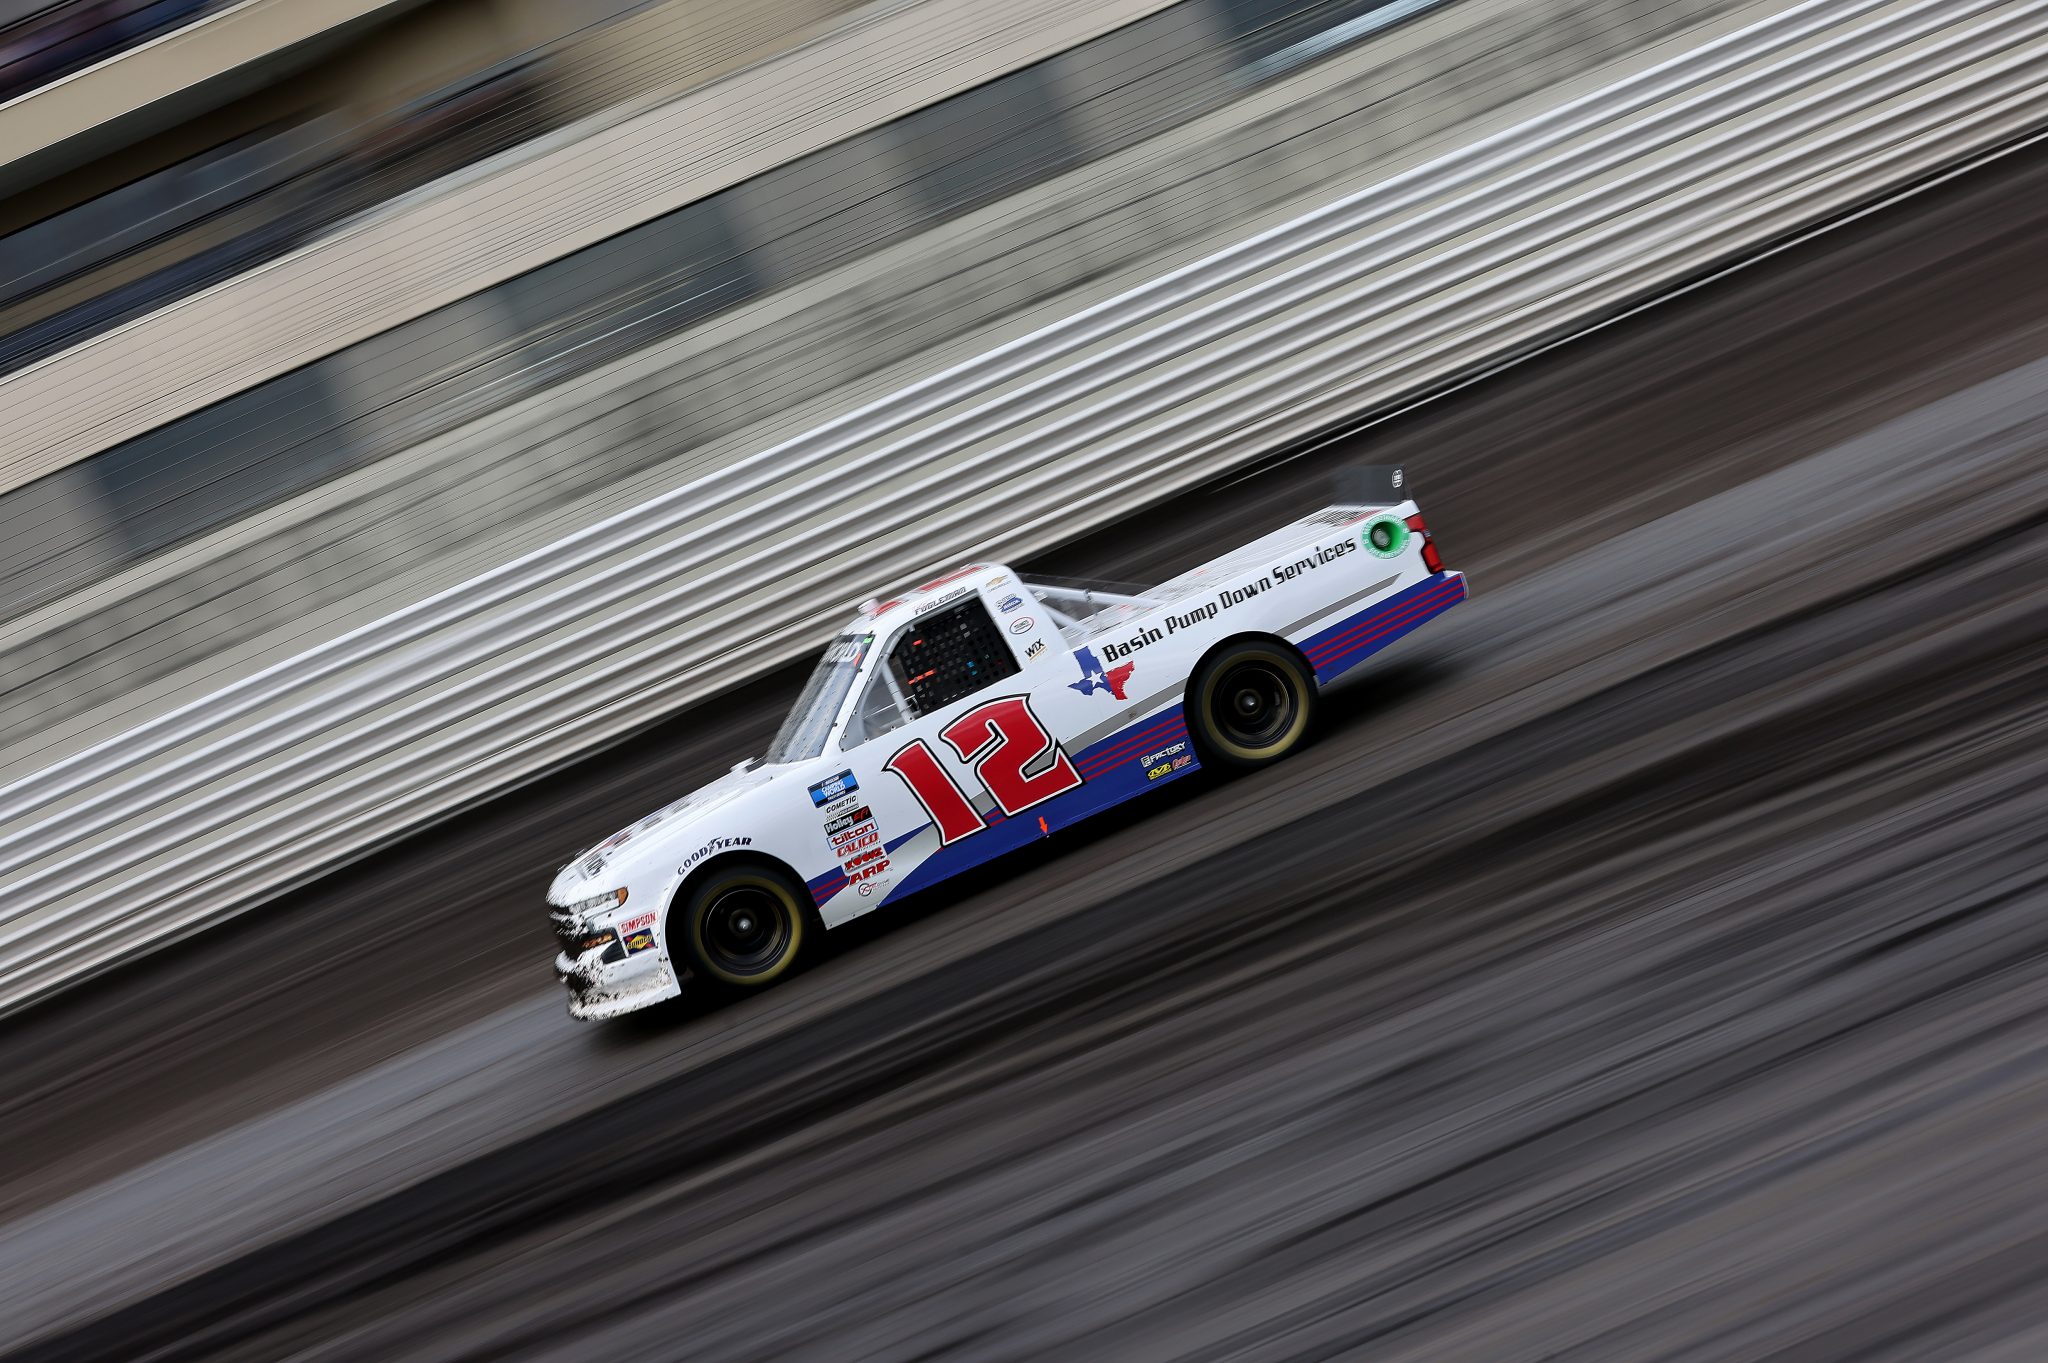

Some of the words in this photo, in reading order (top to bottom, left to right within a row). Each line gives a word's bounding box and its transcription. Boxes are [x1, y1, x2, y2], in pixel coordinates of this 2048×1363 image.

[1101, 627, 1164, 663] Basin
[1165, 601, 1218, 634] Pump
[1218, 576, 1272, 610] Down
[1272, 538, 1357, 586] Services
[1025, 638, 1045, 657] WIX
[881, 693, 1087, 847] 12
[826, 795, 857, 814] COMETIC
[825, 816, 855, 833] Holley
[832, 822, 875, 846] tilton
[678, 836, 752, 876] GOODYEAR
[837, 832, 879, 857] CALICO
[849, 860, 891, 885] ARP
[621, 911, 656, 933] SIMPSON
